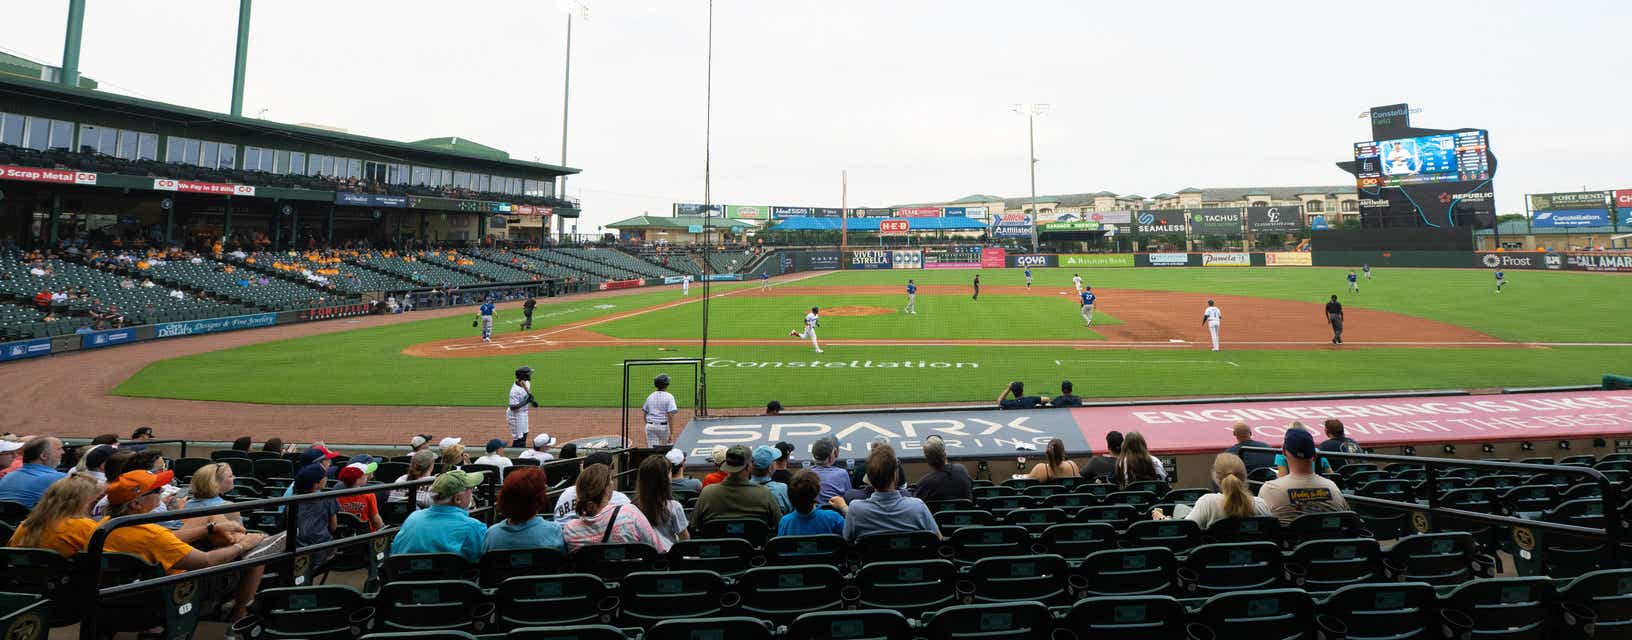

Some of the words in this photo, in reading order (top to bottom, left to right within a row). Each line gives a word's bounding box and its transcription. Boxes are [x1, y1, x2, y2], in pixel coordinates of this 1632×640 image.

[1373, 105, 1422, 118] Constellation
[7, 169, 40, 179] Scrap
[42, 172, 73, 181] Metal
[1205, 214, 1239, 222] TACHUS
[1139, 224, 1185, 232] SEAMLESS
[853, 250, 872, 258] VIVE
[852, 257, 887, 265] ESTRELLA
[1502, 255, 1532, 266] Frost
[1576, 255, 1598, 267] CALL
[704, 359, 980, 369] Constellation
[1133, 402, 1473, 424] ENGINEERING
[1456, 399, 1520, 413] IS
[1503, 396, 1629, 411] LIKE
[1446, 415, 1546, 430] THE
[697, 415, 1047, 444] SPARX
